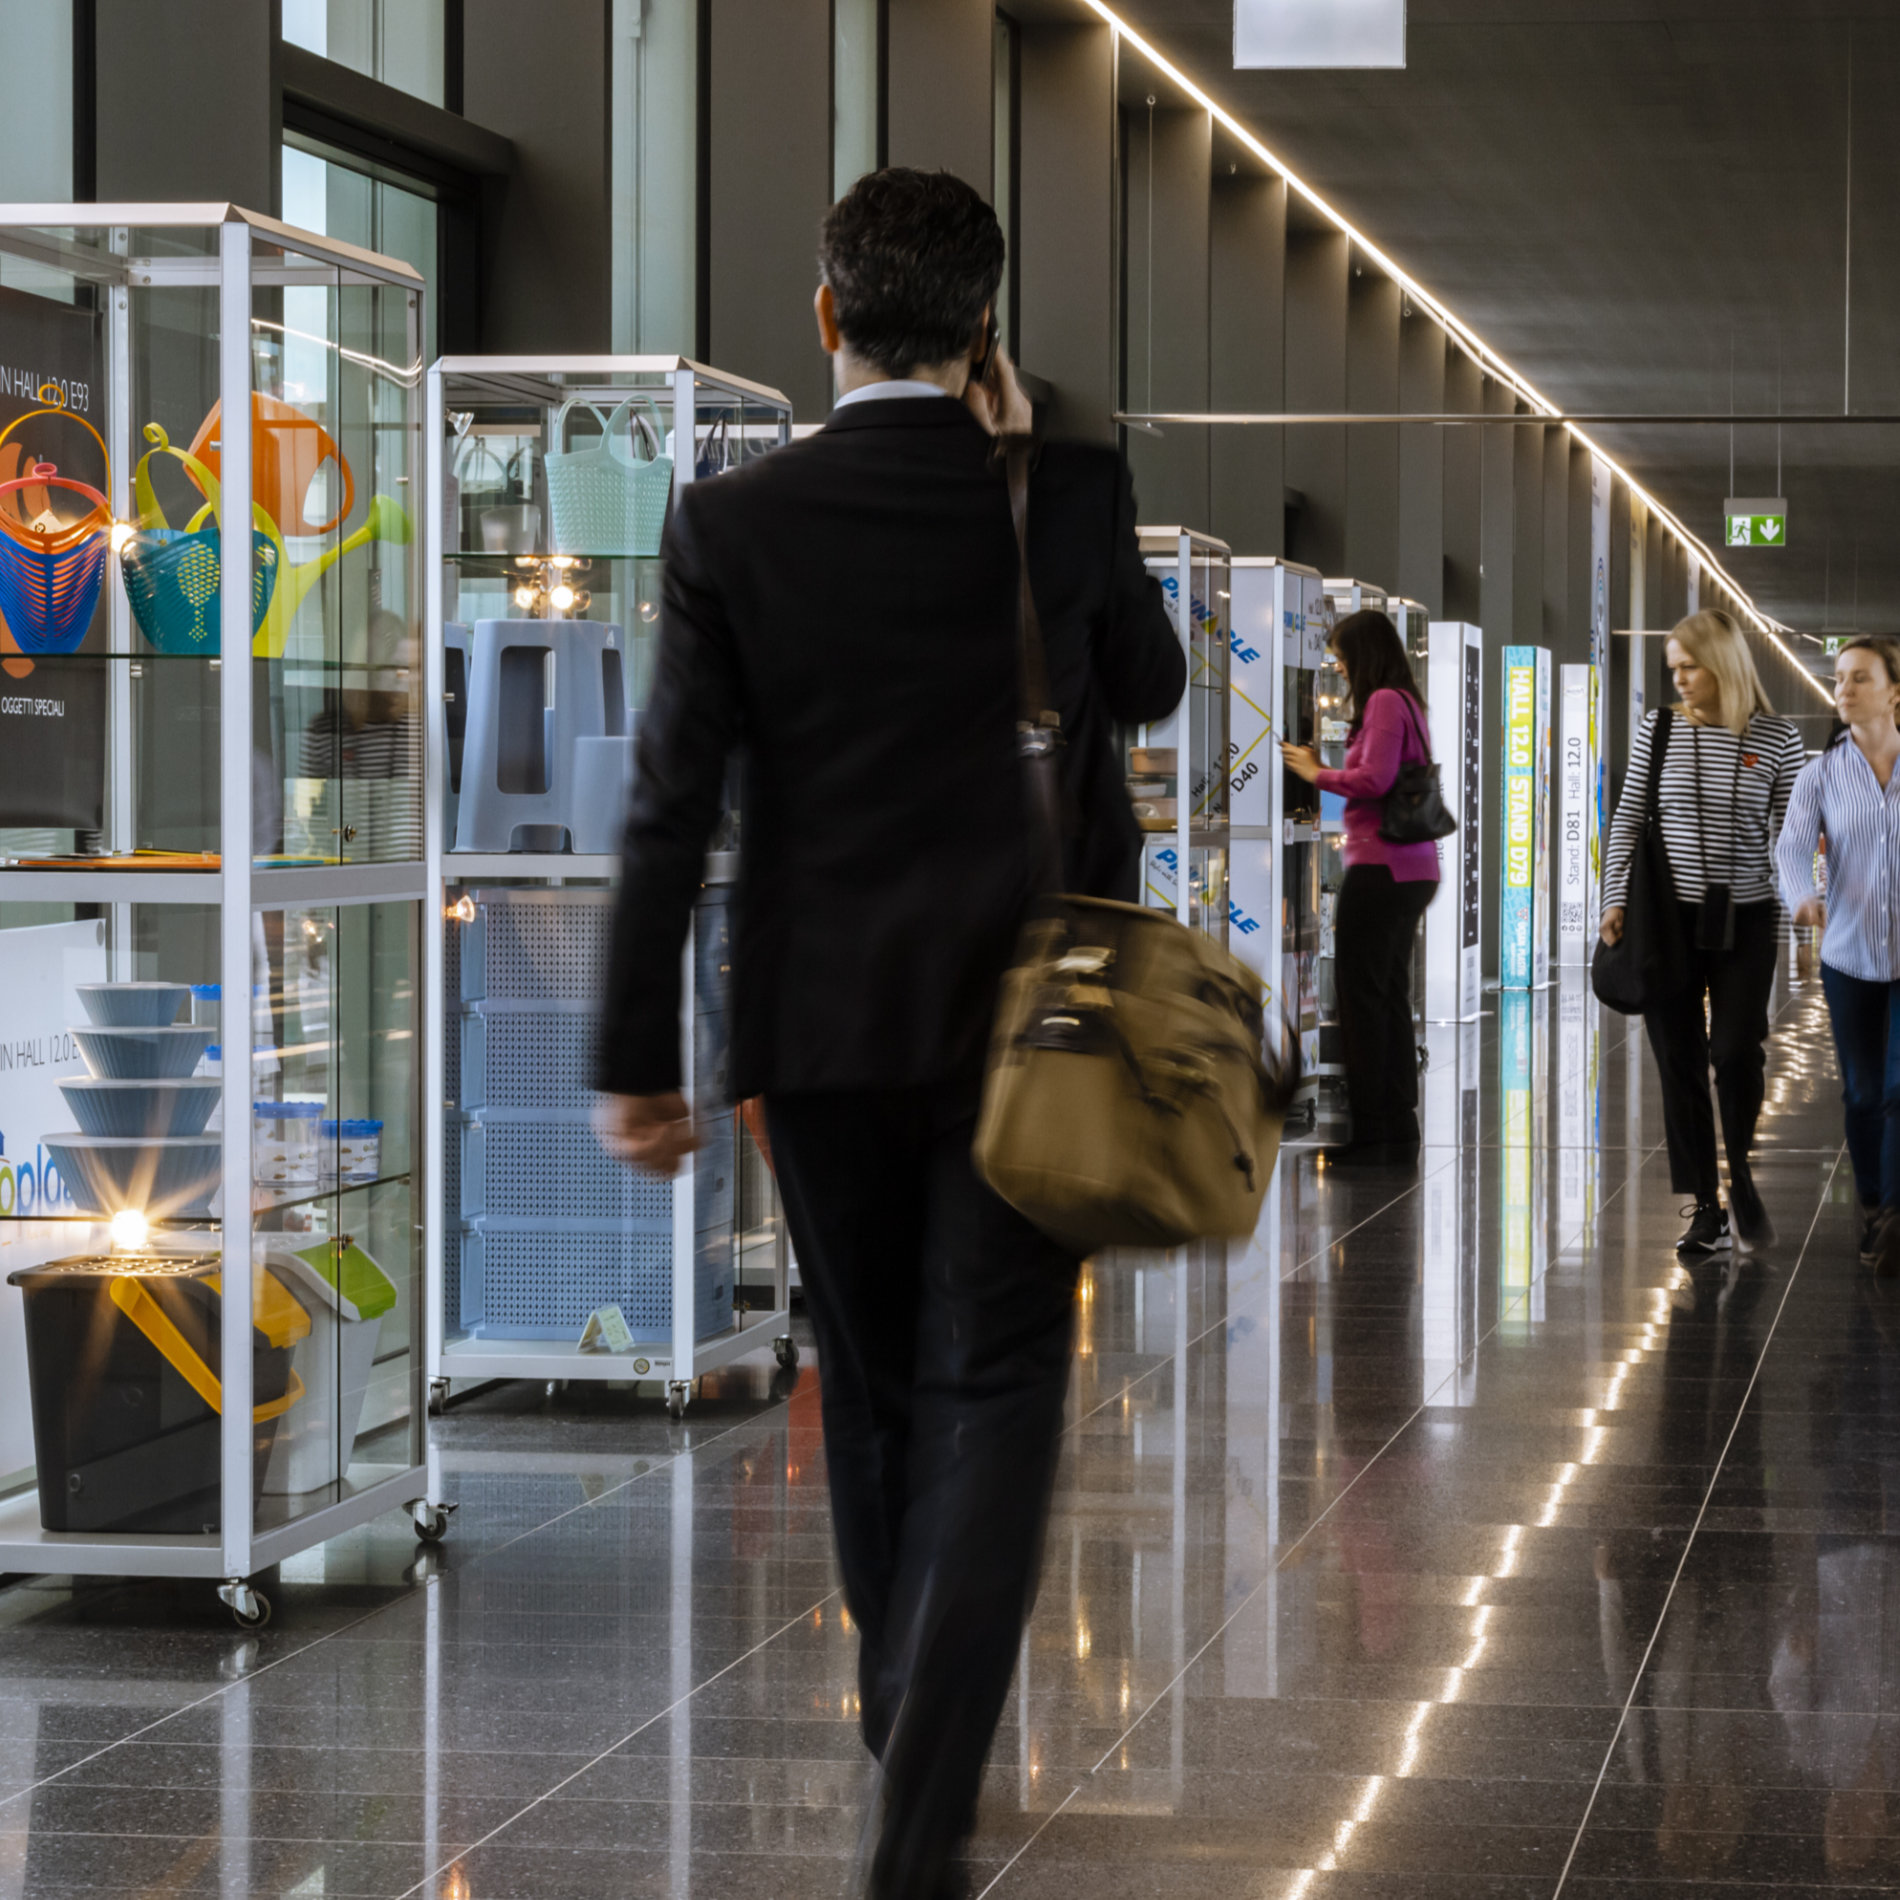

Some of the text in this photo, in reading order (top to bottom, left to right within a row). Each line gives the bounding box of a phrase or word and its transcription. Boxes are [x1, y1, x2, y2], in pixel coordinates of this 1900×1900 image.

[14, 368, 42, 402] HALL
[47, 376, 68, 408] 12.0
[71, 381, 89, 412] E93
[1, 696, 65, 717] OGGETTI SPECIALI
[1230, 762, 1259, 792] D40
[1510, 669, 1530, 885] HALL 12.0 STAND D79
[1567, 737, 1581, 885] Stand: D81 Hall: 12.0
[0, 1041, 13, 1071] IN
[16, 1038, 45, 1068] HALL
[49, 1033, 70, 1063] 12.0
